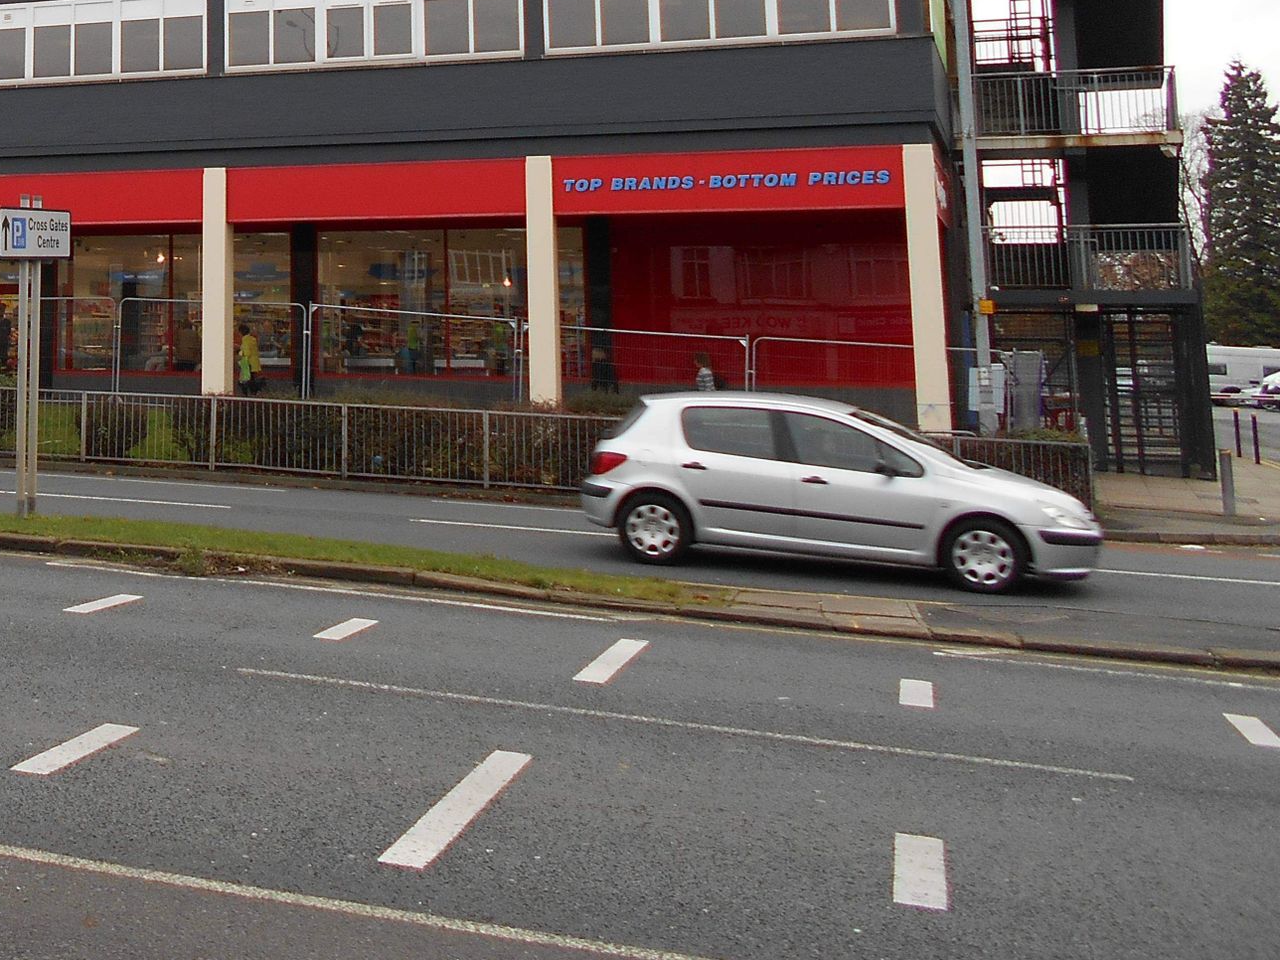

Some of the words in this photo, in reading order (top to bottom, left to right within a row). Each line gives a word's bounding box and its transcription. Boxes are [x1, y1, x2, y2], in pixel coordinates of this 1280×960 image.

[563, 178, 603, 192] TOP
[611, 175, 694, 190] BRANDS
[709, 173, 797, 189] BOTTOM
[808, 170, 890, 186] PRICES
[28, 217, 48, 231] Cross
[49, 218, 68, 232] Gates
[37, 234, 60, 249] Centre
